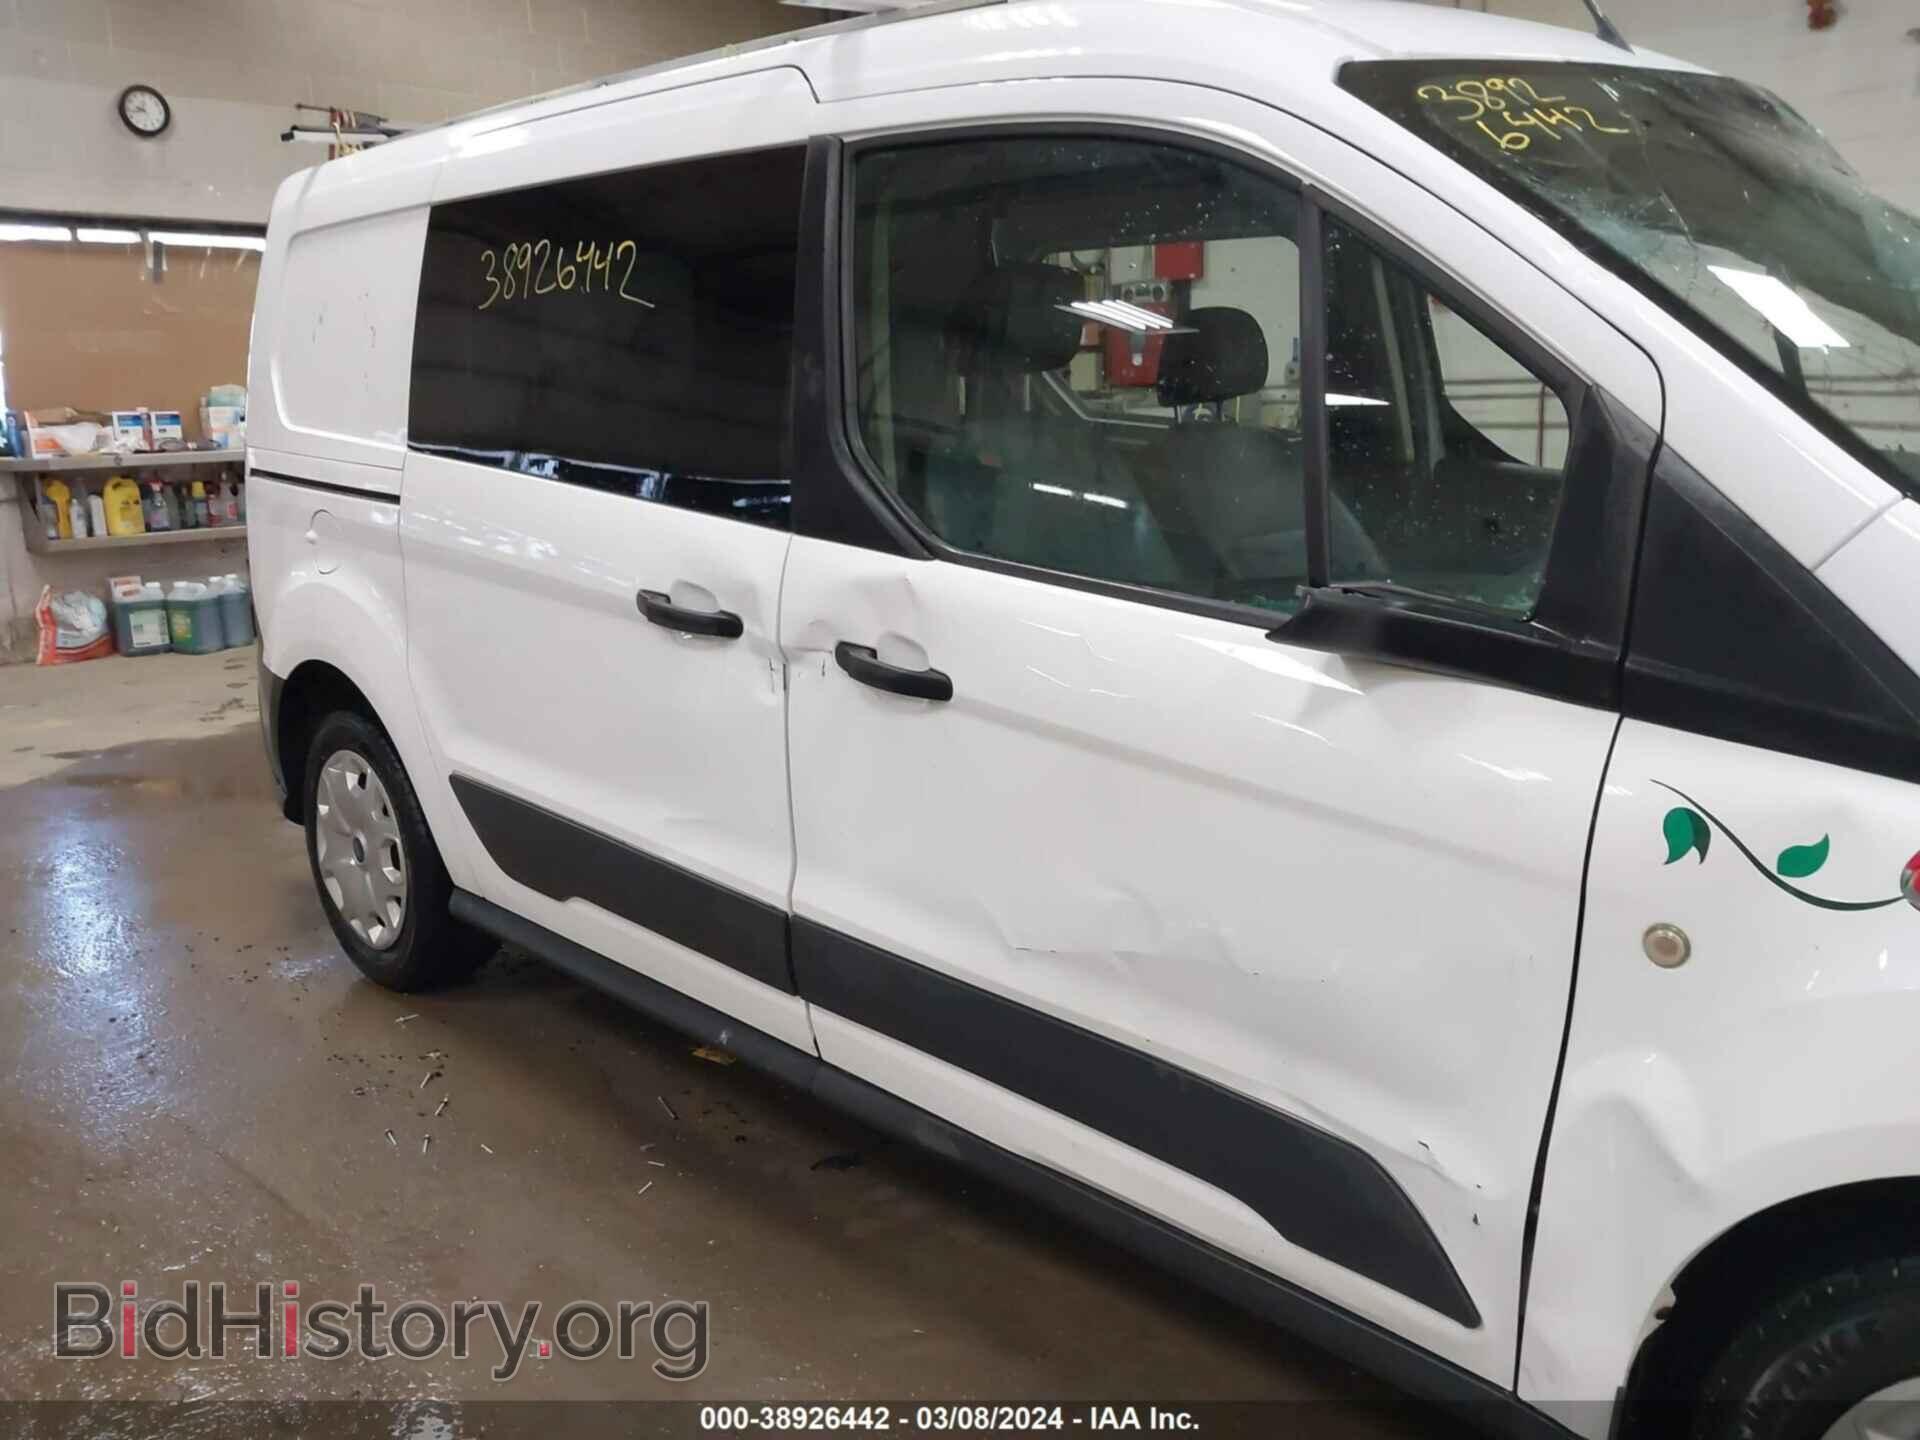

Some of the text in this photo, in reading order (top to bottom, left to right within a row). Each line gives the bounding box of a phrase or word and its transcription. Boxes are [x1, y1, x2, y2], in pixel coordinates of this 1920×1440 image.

[1417, 78, 1566, 121] 3892
[1476, 106, 1630, 150] 6442
[478, 239, 655, 310] 38926442
